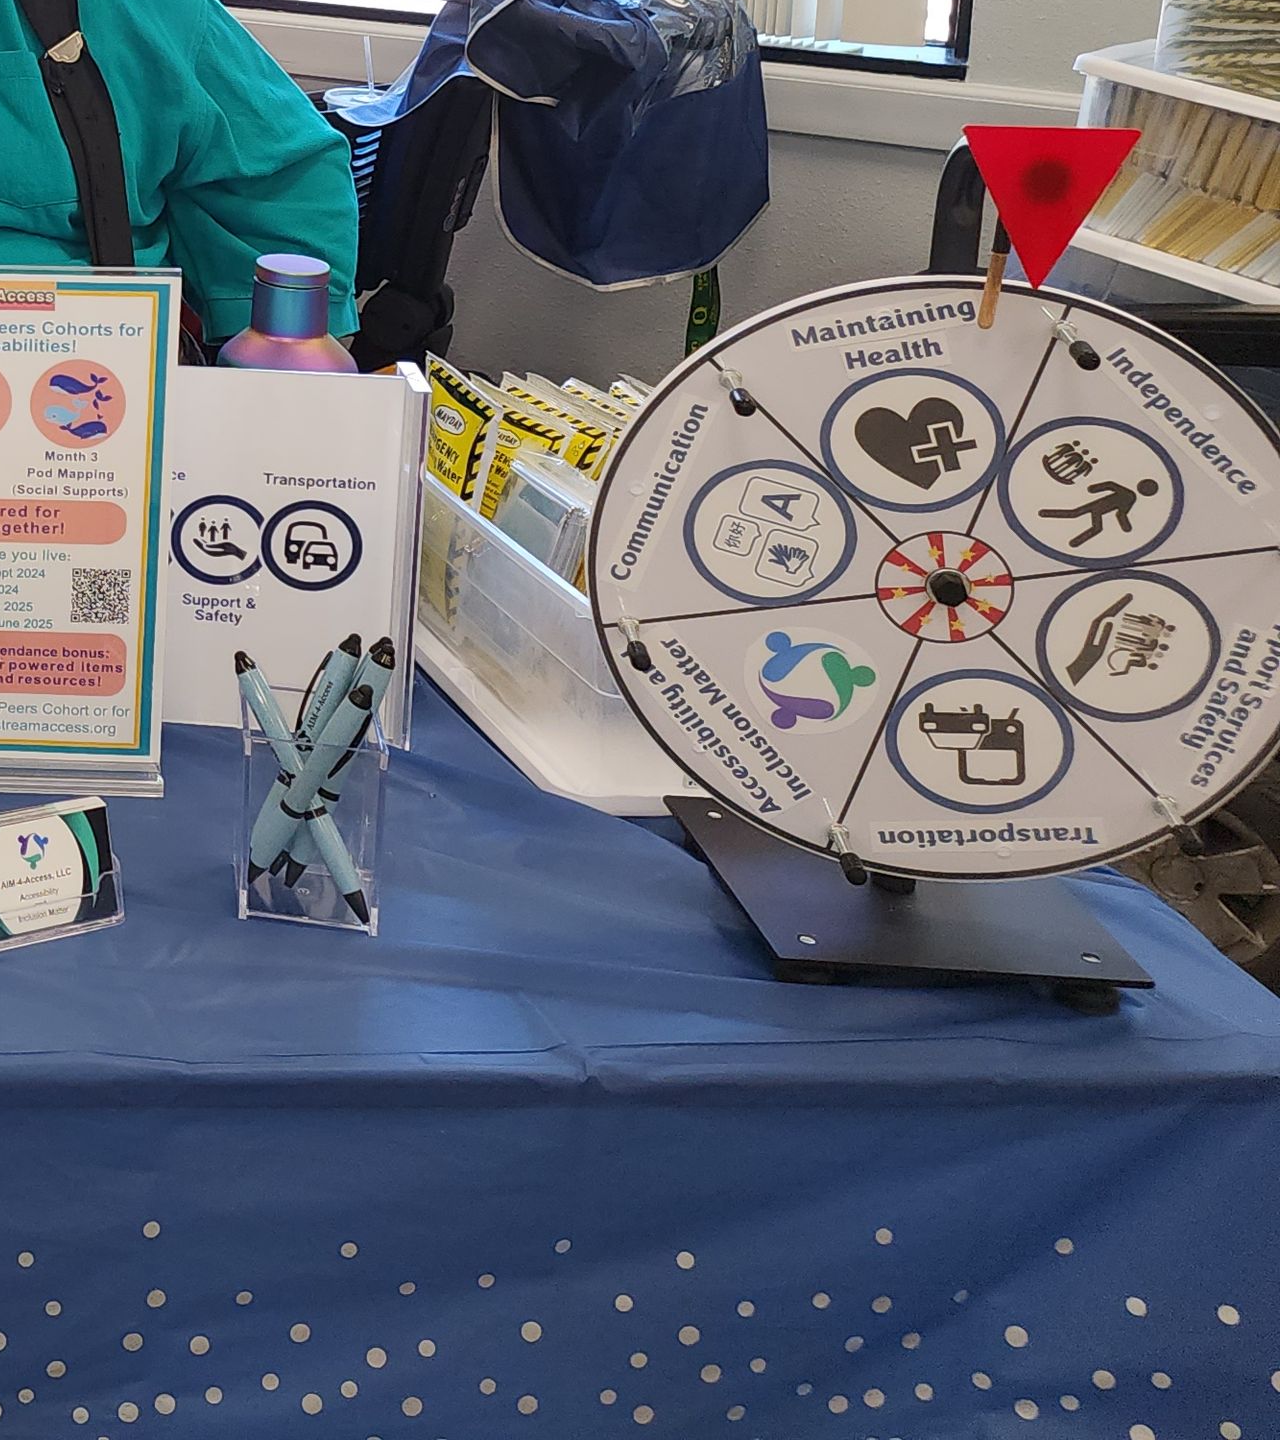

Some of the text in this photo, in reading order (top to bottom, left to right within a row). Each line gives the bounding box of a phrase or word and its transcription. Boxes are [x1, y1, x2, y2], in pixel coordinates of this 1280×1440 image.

[42, 321, 113, 337] Cohorts
[119, 323, 143, 337] for
[791, 297, 976, 347] Maintaining
[845, 337, 943, 370] Health
[436, 409, 462, 429] MAYDAY
[1106, 346, 1258, 495] Independence
[44, 451, 98, 461] Month 3
[27, 468, 115, 482] Pod Mapping
[264, 472, 376, 491] Transportation
[12, 484, 129, 498] (Social Supports)
[610, 401, 710, 583] Communication
[35, 506, 61, 518] for
[761, 494, 802, 522] A
[11, 550, 37, 563] you
[42, 549, 71, 562] live:
[182, 593, 256, 609] Support &
[195, 609, 242, 626] Safety
[1180, 629, 1256, 750] and Safety
[42, 703, 89, 716] Cohort
[93, 706, 108, 716] or
[111, 704, 130, 718] for
[306, 681, 334, 731] AIM-4-Access
[661, 638, 812, 801] Inclusion Matter
[661, 684, 782, 814] Accessibility
[1191, 692, 1263, 788] Services
[877, 823, 1098, 847] Transportation
[1, 868, 71, 890] AIM-4-Access, LLC
[19, 887, 59, 902] Accessibility
[18, 906, 69, 924] Inclusion Matter
